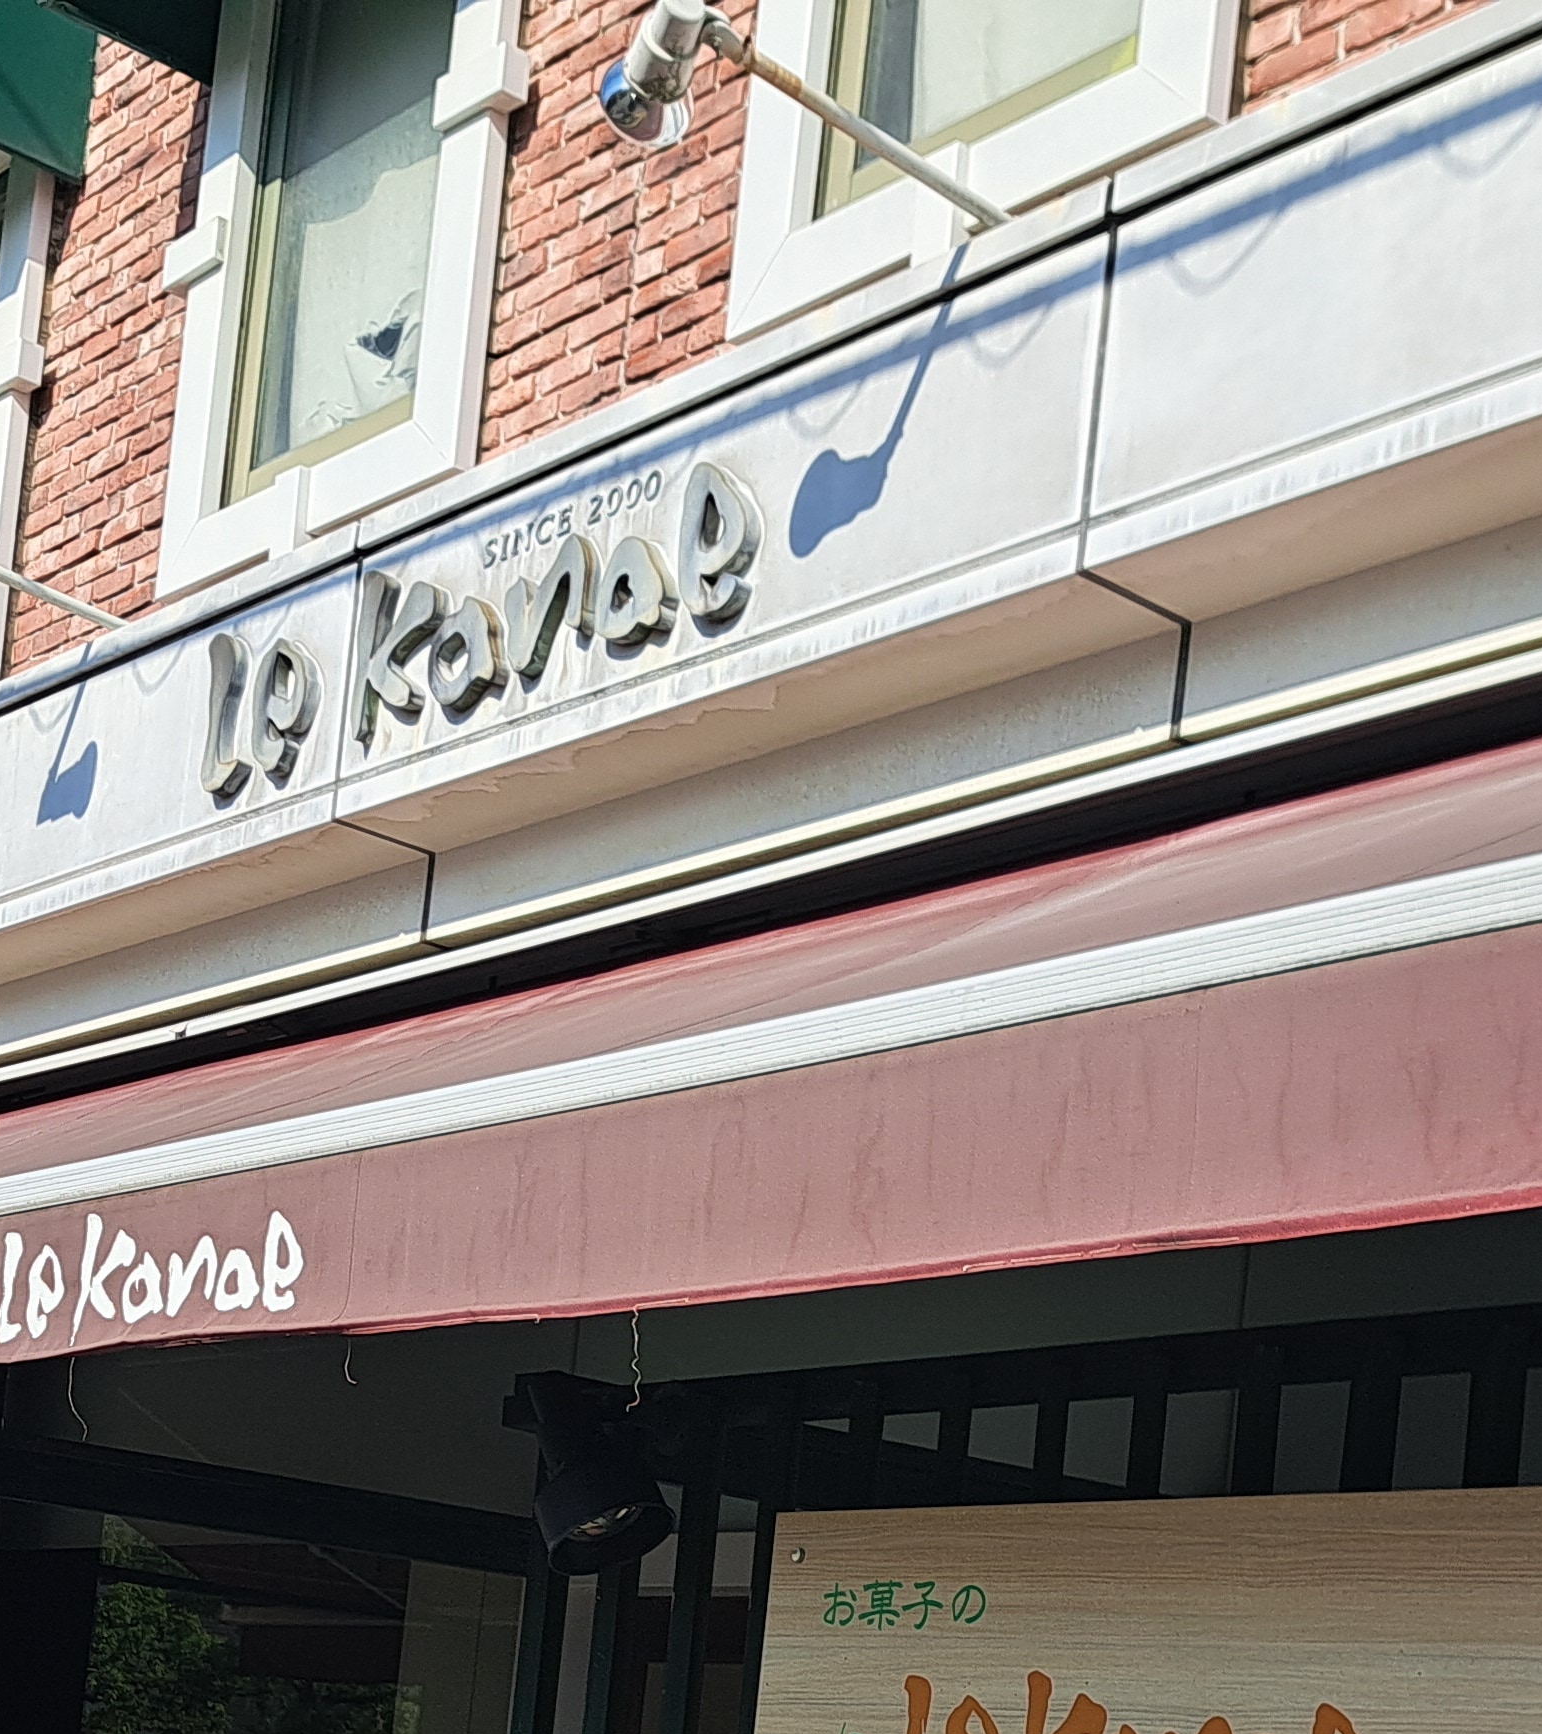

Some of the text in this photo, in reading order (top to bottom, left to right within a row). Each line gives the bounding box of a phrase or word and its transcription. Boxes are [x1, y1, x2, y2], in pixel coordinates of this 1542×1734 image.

[482, 470, 662, 569] SINCE 2000
[352, 461, 762, 756] Kanae
[69, 1210, 305, 1347] Kanae
[822, 1579, 988, 1631] お菓子の
